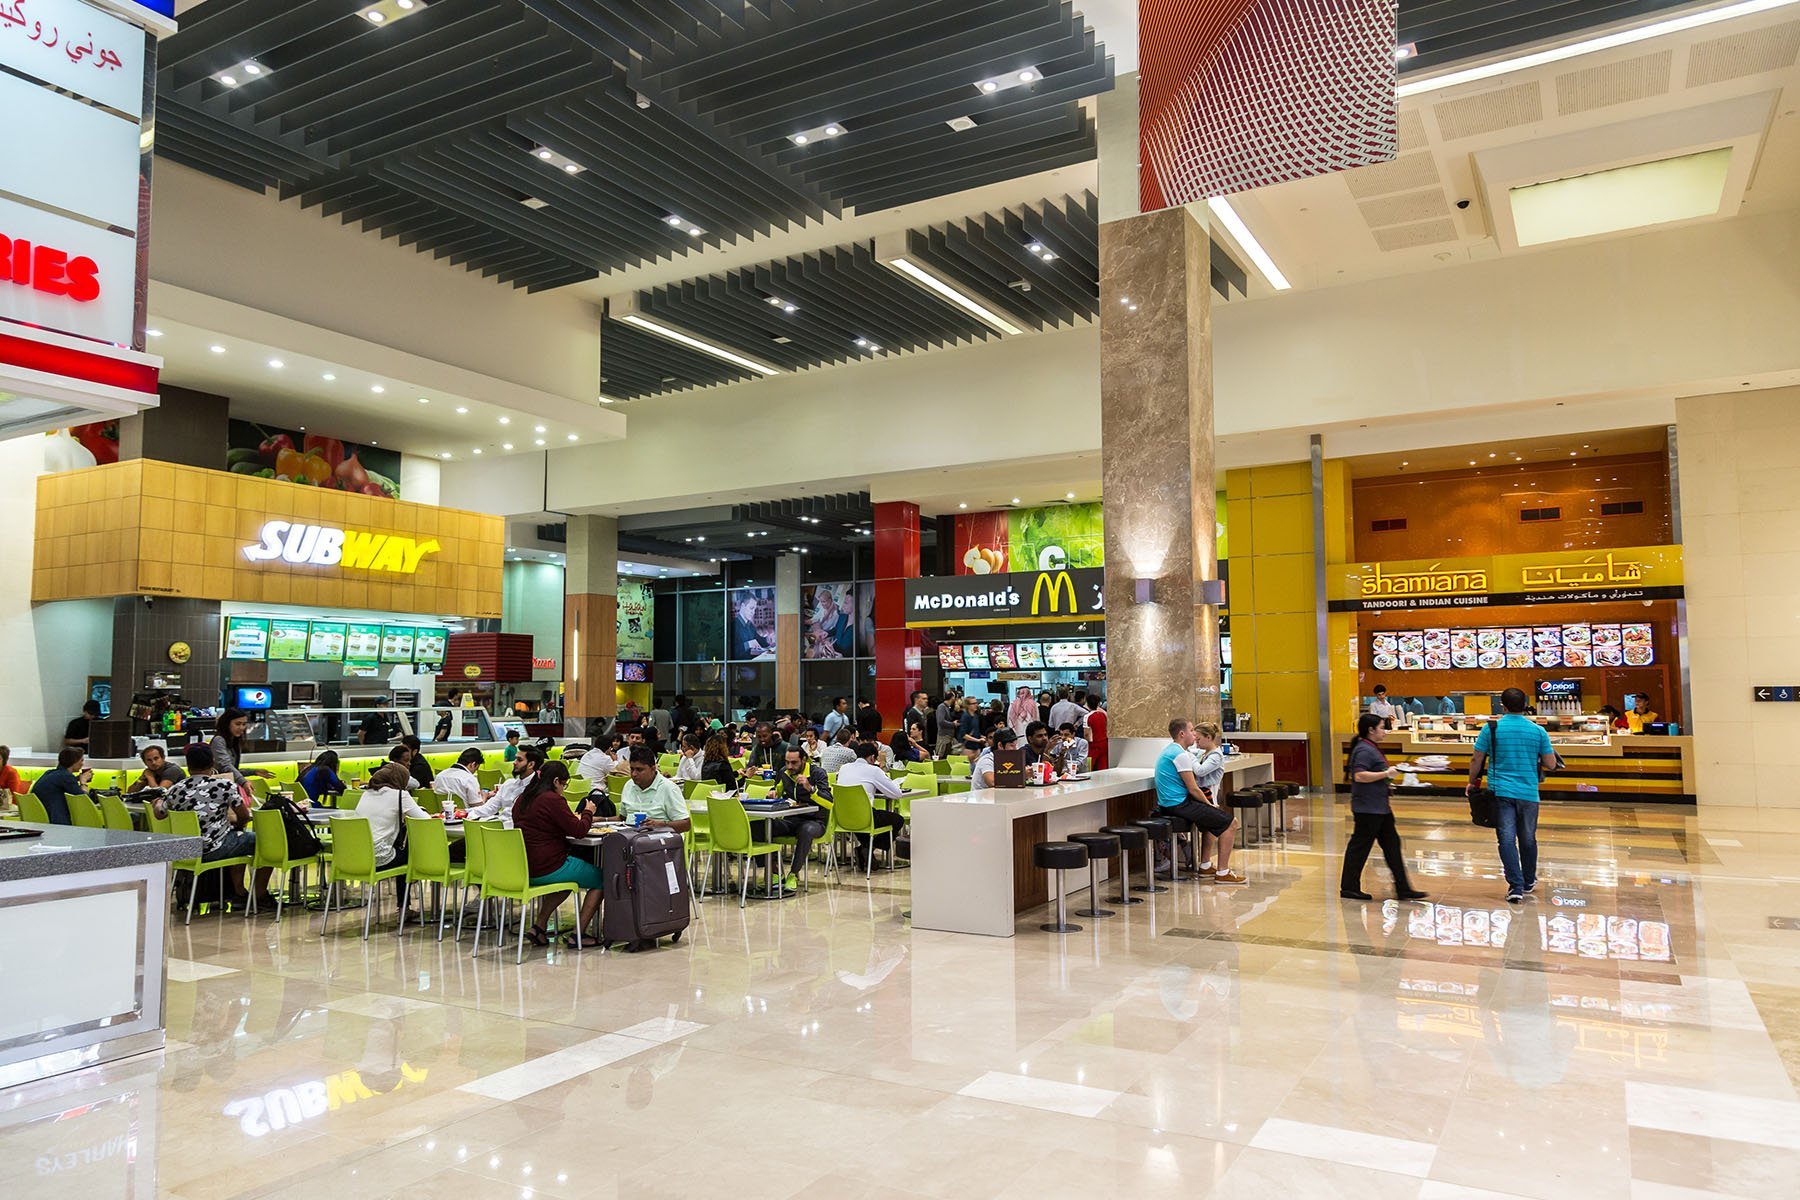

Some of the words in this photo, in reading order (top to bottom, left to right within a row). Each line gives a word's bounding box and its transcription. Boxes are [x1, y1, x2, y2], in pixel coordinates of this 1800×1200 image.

[0, 0, 58, 47] روكي
[65, 32, 122, 71] جوني
[241, 520, 441, 574] SUBWAY
[914, 586, 1020, 610] McDonald's
[1363, 600, 1407, 608] TANDOORI
[1409, 599, 1417, 607] &
[1419, 598, 1451, 606] INDIAN
[1453, 596, 1488, 605] CUISINE
[1552, 682, 1575, 691] pepsi
